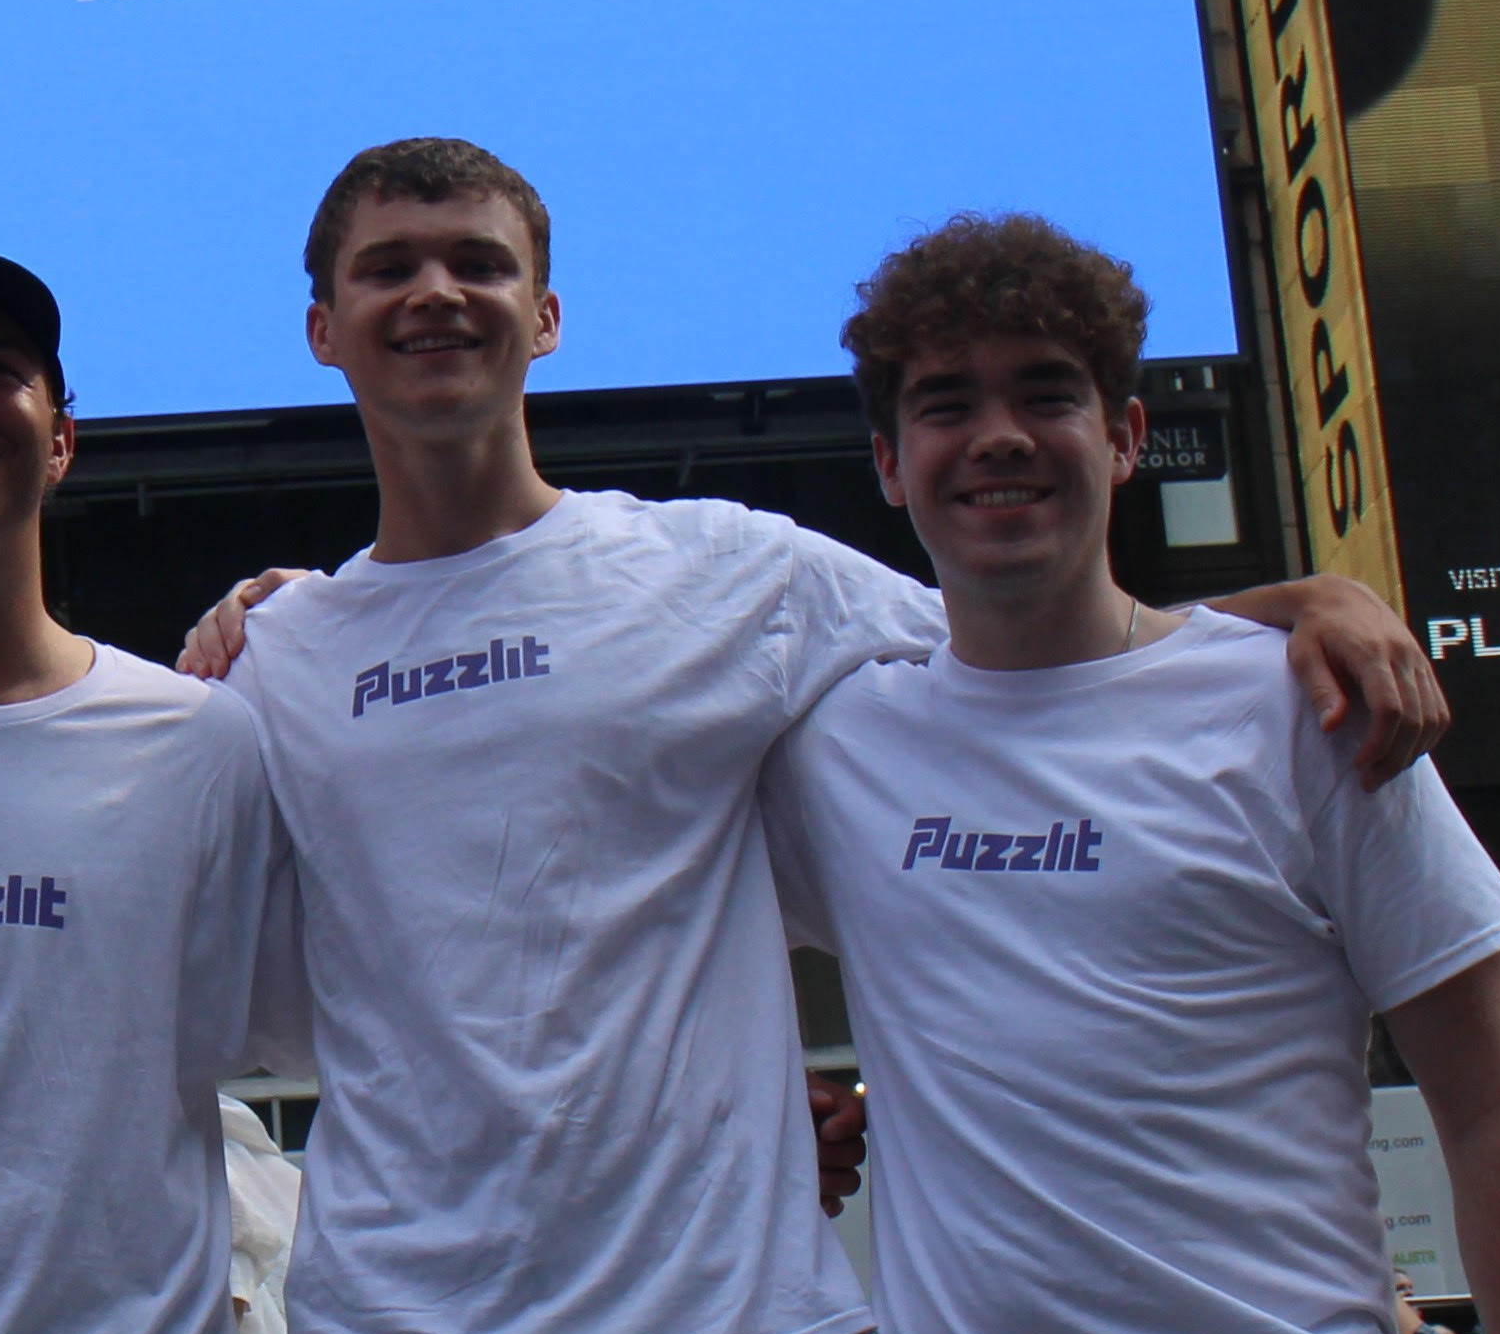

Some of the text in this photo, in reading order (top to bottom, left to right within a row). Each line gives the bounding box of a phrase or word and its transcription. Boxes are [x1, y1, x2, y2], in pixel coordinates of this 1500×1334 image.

[1137, 452, 1207, 468] COLOR
[352, 634, 551, 719] Puzzlit
[902, 816, 1102, 871] Puzzlit
